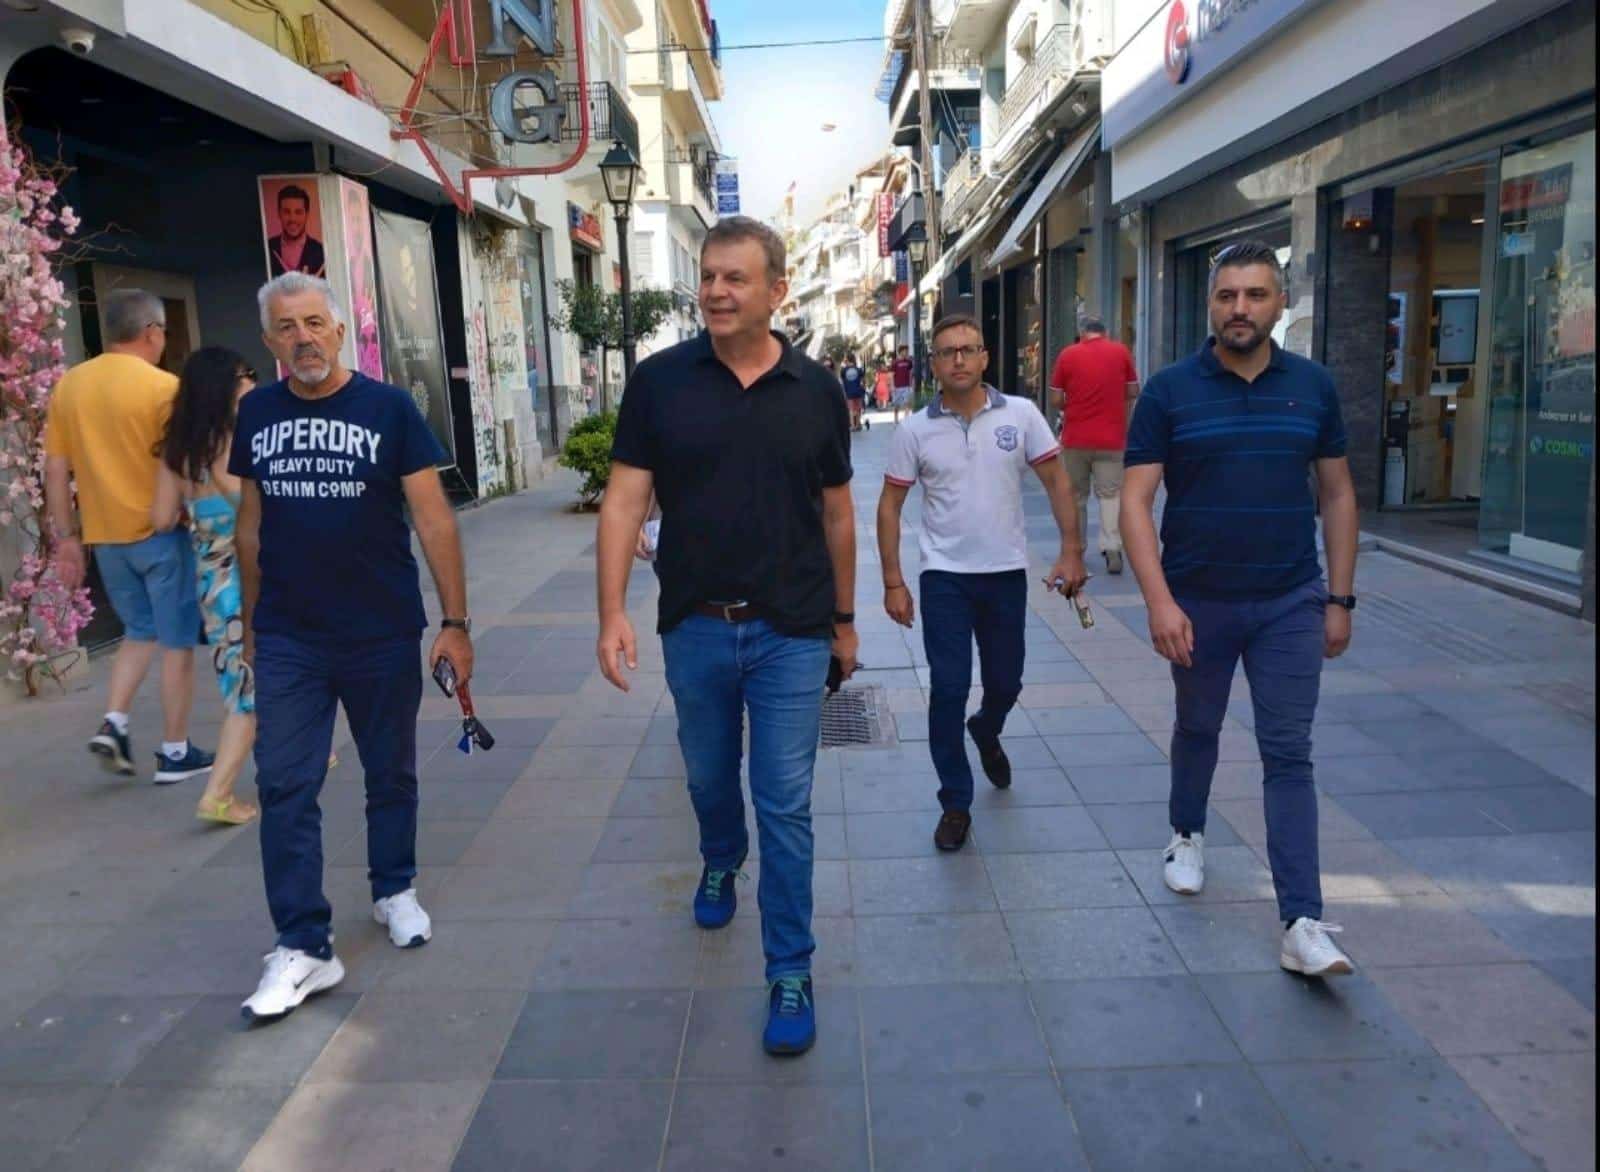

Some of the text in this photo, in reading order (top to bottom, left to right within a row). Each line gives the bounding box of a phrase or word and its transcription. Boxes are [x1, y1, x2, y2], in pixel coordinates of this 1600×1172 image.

[251, 417, 381, 465] SUPERDRY
[269, 457, 355, 476] HEAVY DUTY
[262, 480, 315, 498] DENIM
